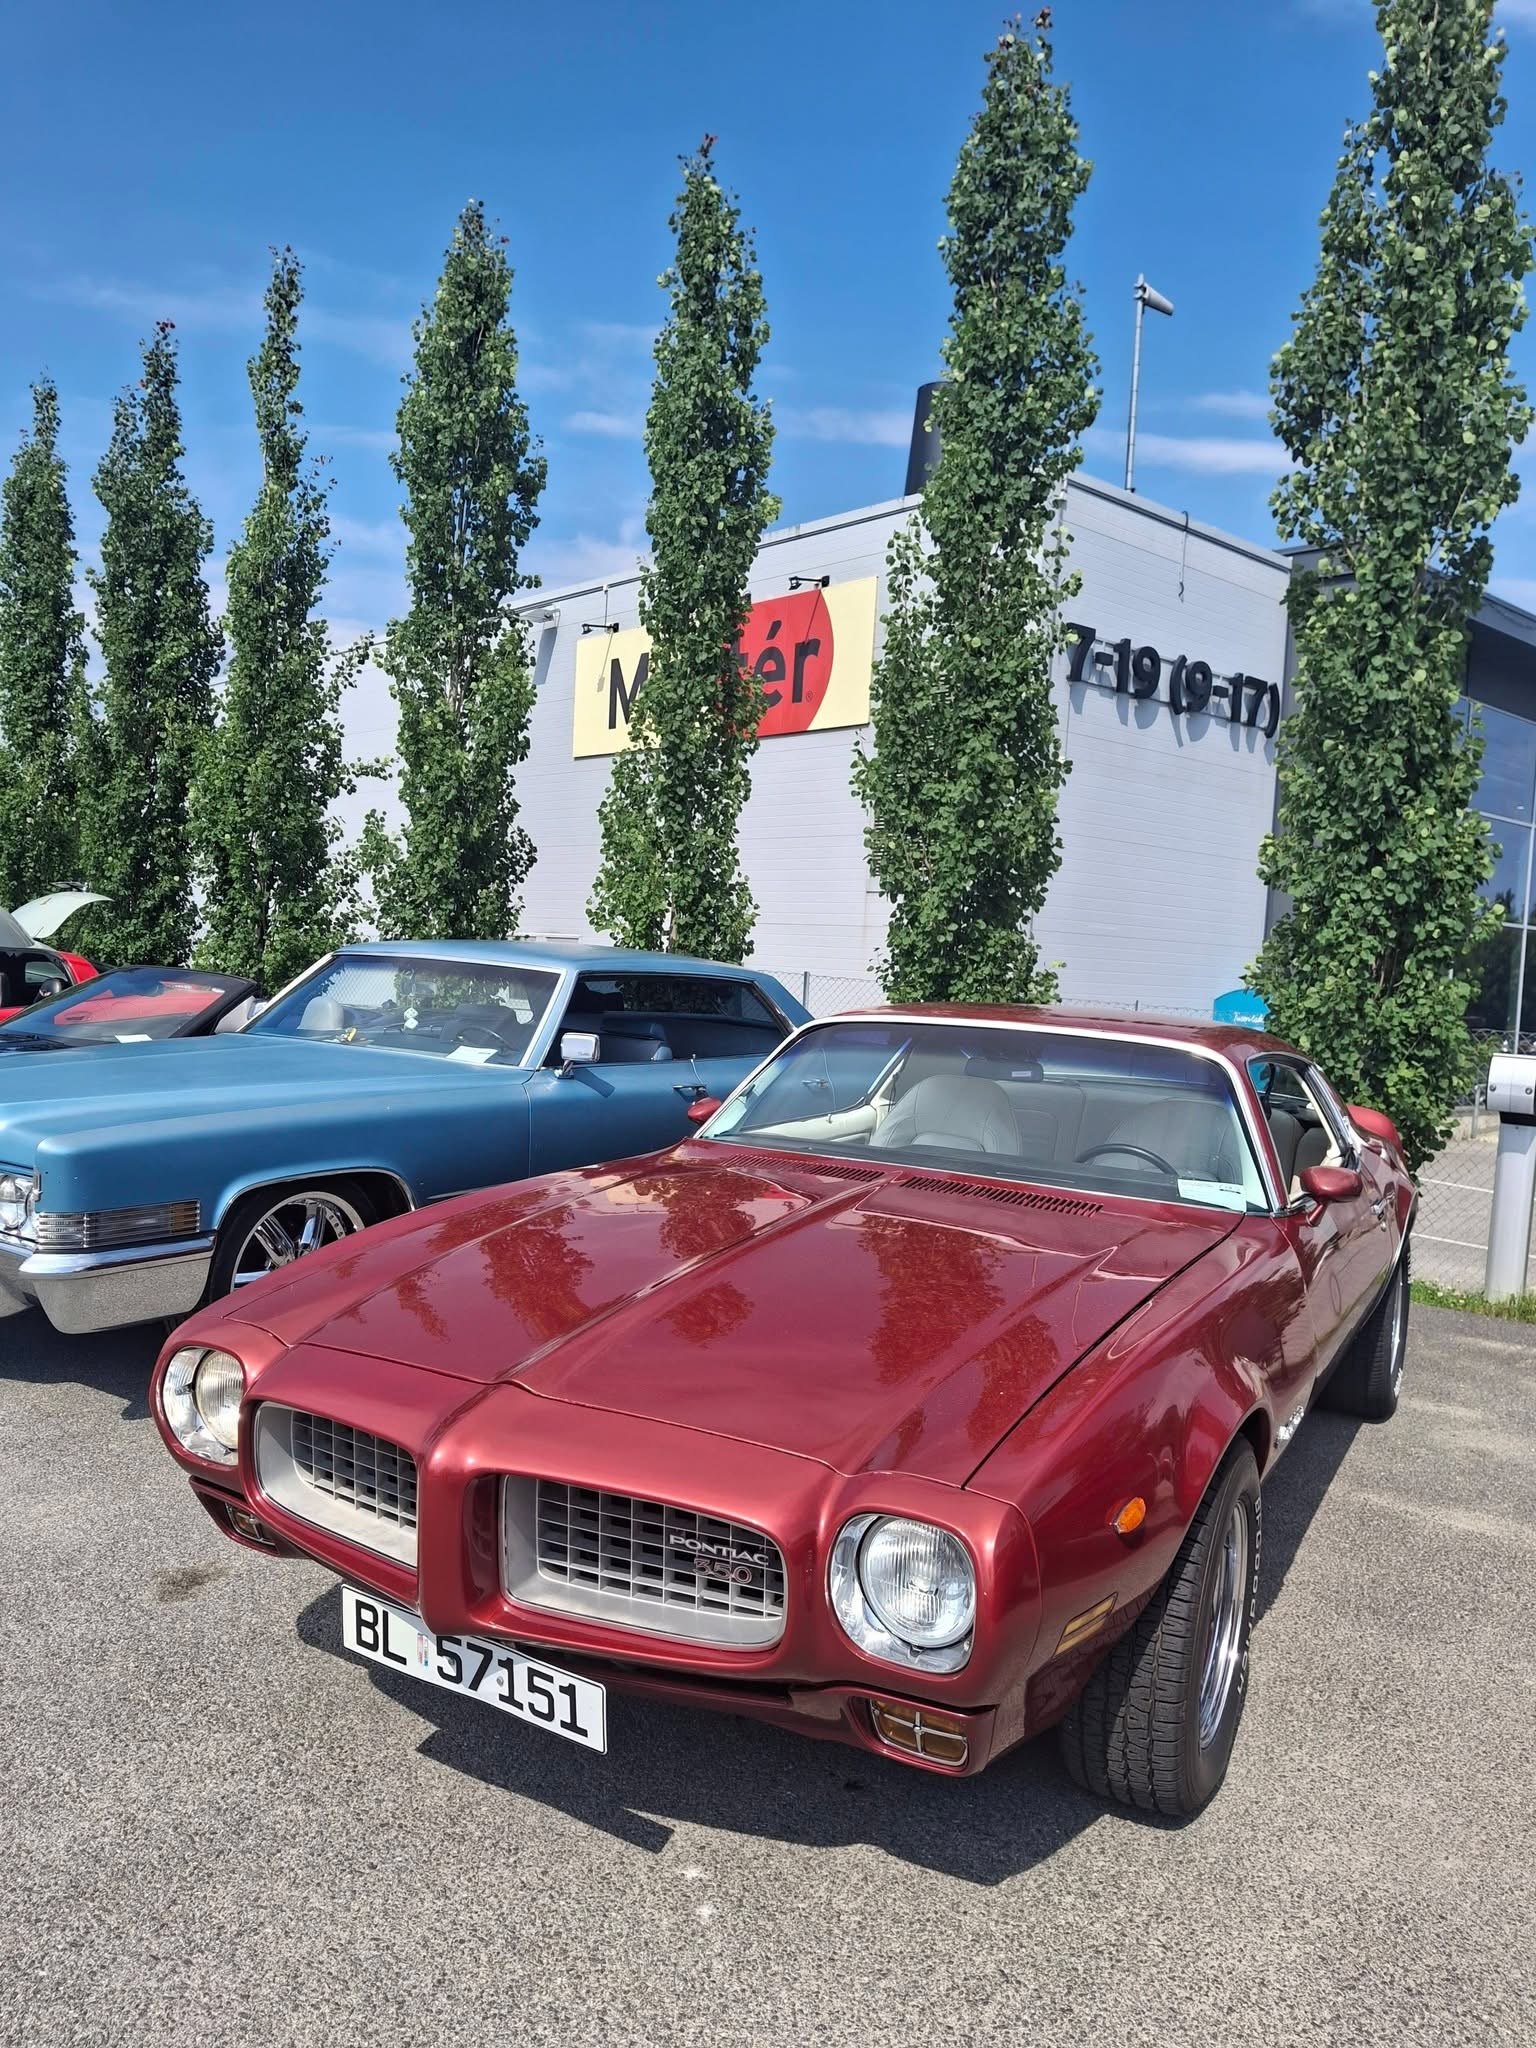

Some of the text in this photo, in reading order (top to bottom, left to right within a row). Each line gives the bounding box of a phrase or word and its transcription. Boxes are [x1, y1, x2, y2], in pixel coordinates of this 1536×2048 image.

[608, 619, 821, 730] Mtér
[1066, 622, 1280, 739] 7-19 (9-17)
[668, 1534, 769, 1566] PONTIAC
[692, 1557, 753, 1584] 350
[355, 1599, 589, 1738] BL 57151
